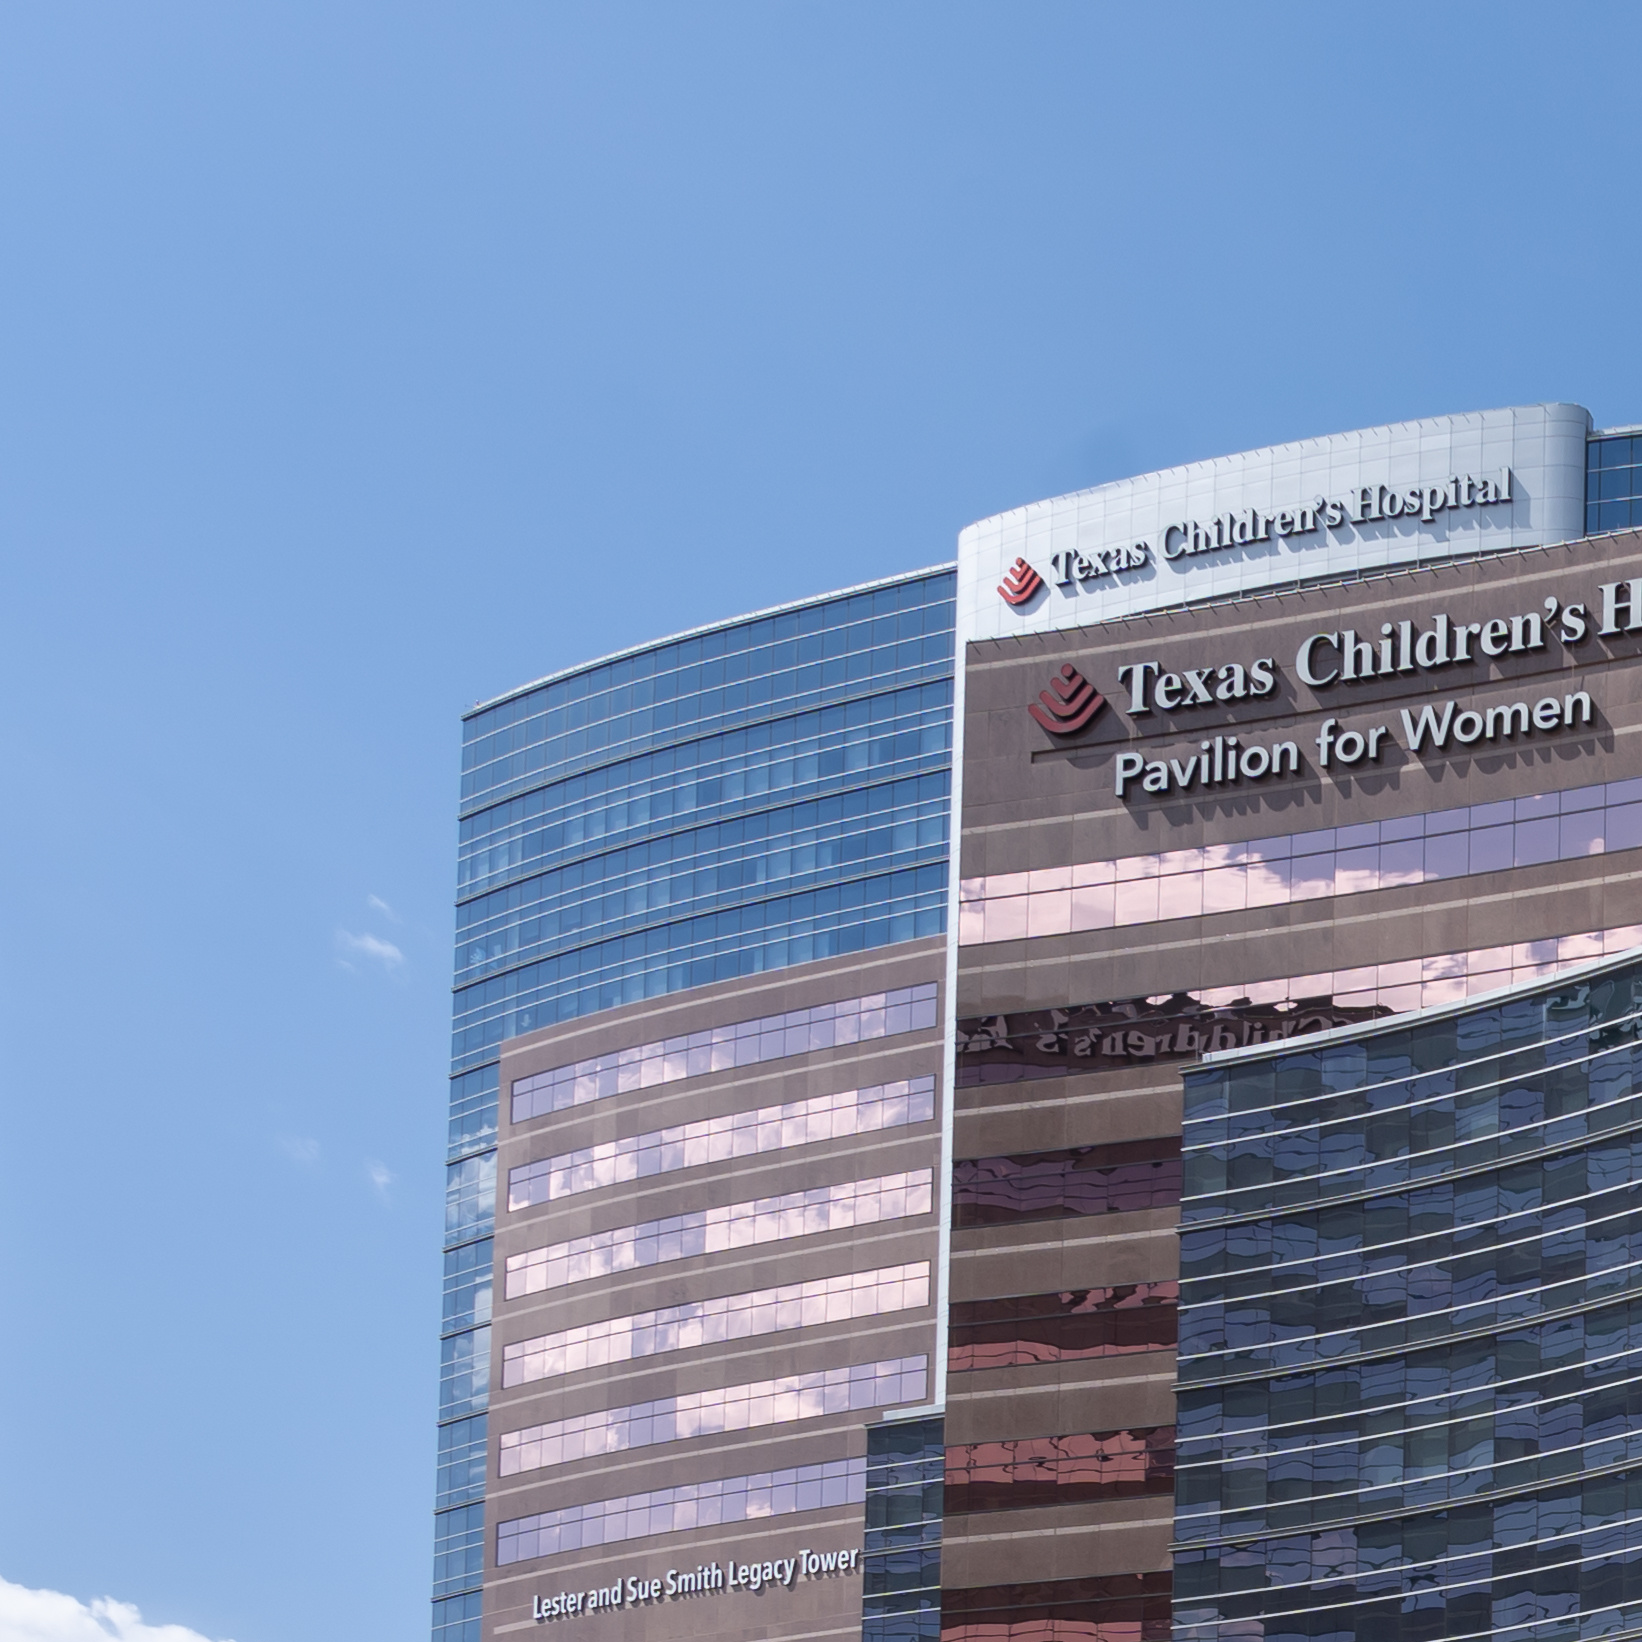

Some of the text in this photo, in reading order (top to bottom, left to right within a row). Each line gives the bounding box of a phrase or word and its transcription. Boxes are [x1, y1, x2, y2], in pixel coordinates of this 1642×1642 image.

[1048, 468, 1512, 588] Texas Children's Hospital
[1117, 658, 1276, 717] Texas
[1296, 598, 1587, 687] Children's
[1115, 691, 1593, 798] Pavilion for Women
[533, 1548, 859, 1619] Lester and Sue Smith Legacy Tower
